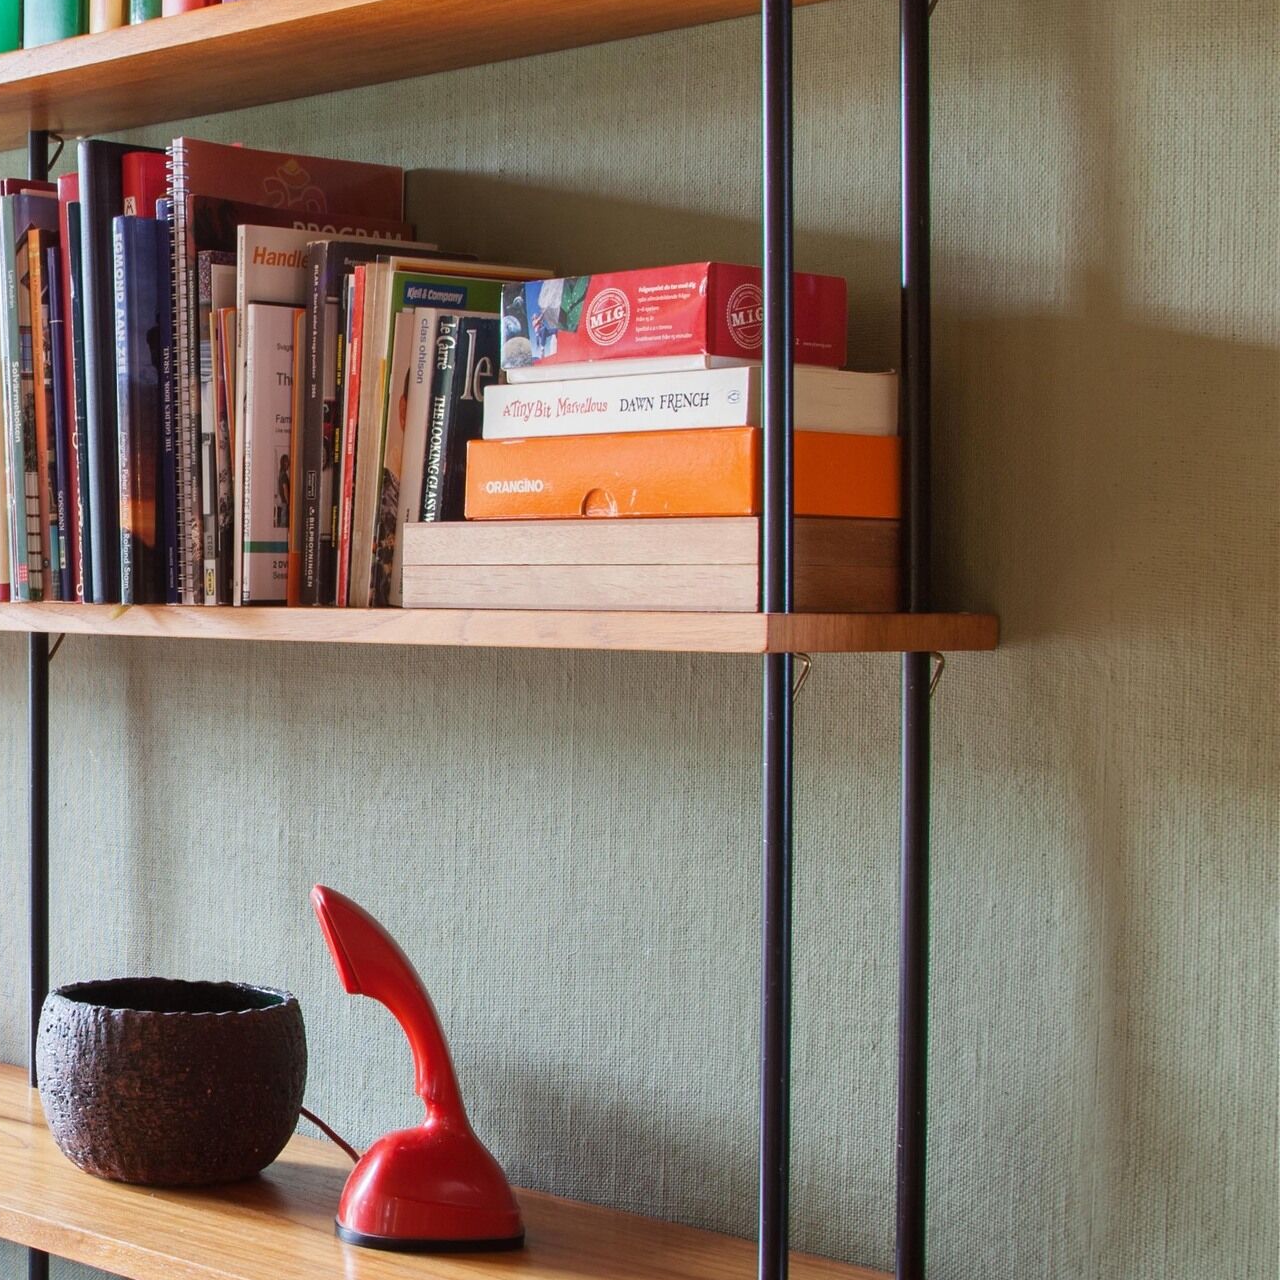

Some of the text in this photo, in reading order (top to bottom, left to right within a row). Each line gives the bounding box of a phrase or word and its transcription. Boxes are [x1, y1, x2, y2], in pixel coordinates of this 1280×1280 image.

[115, 231, 126, 375] EGMOND AAN ZEE
[407, 286, 463, 304] Kjell Company
[590, 305, 627, 329] M.I.G.
[163, 346, 171, 374] ISRAEL
[416, 318, 428, 384] clas ohlson
[436, 322, 456, 371] le Carré
[460, 329, 494, 403] le
[11, 361, 22, 443] Solvärmeboken
[164, 380, 172, 403] BOOK
[619, 391, 710, 413] DAWN FRENCH
[164, 404, 172, 435] GOLDEN
[503, 393, 608, 423] A Tiny Bit Marvellous
[424, 395, 447, 513] THE LOOKING GLASS
[122, 532, 130, 564] Roland
[307, 517, 316, 588] BILPROVNINGEN
[123, 567, 131, 589] Stam
